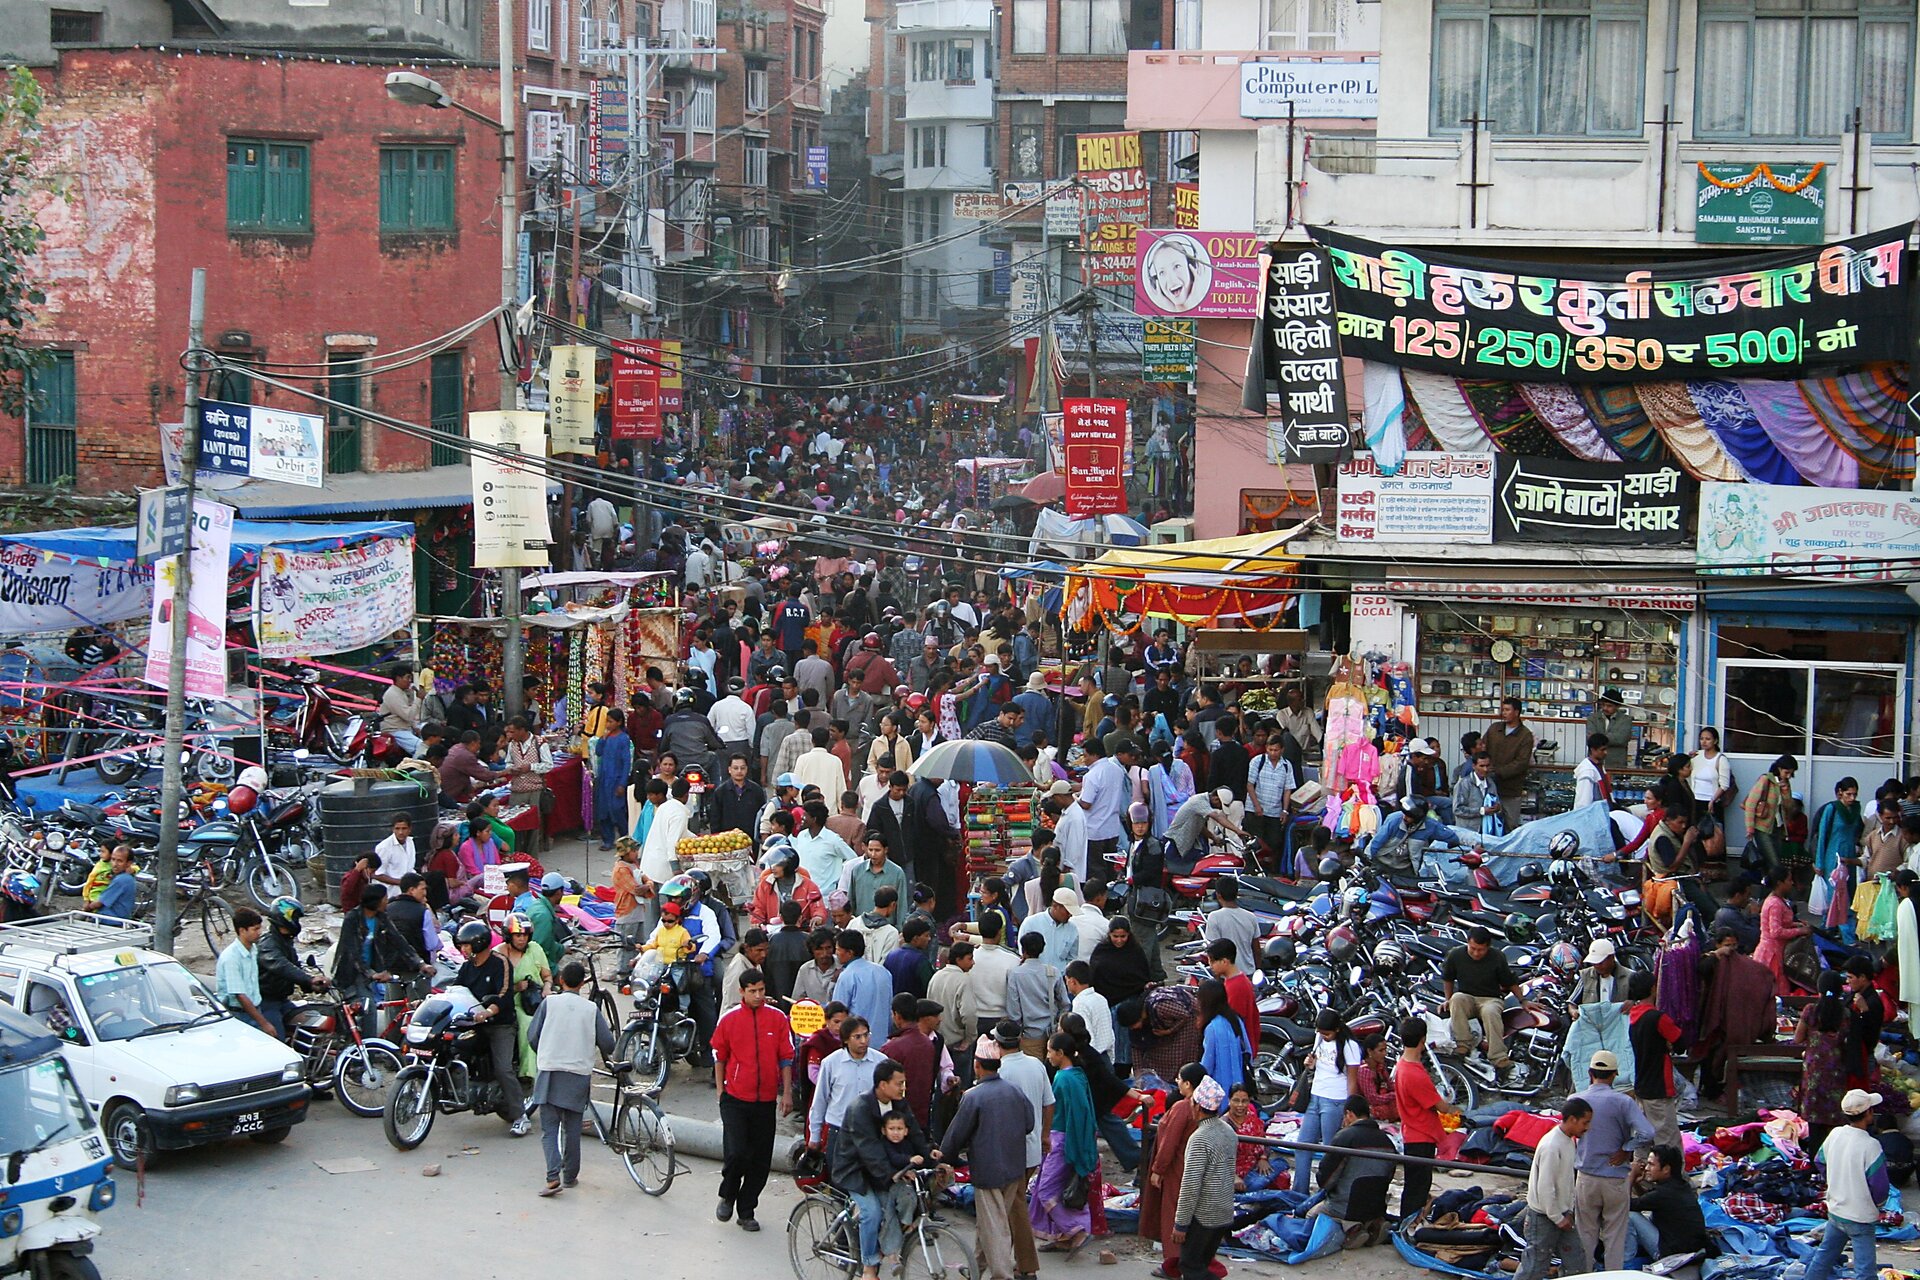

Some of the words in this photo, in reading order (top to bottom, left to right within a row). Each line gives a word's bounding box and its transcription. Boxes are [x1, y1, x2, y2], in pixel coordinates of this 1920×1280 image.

[1258, 66, 1295, 82] Plus
[1245, 78, 1338, 98] Computer
[1108, 169, 1145, 193] SLC
[1698, 215, 1736, 223] SAMJHANA
[1738, 215, 1779, 224] BAHUMUKHI
[1782, 216, 1819, 225] SAHAKARI
[1735, 225, 1771, 235] SANSTHA
[1207, 236, 1258, 259] OSIZ
[1270, 251, 1322, 291] साड़ी
[1330, 246, 1427, 308] साड़ी
[1653, 261, 1816, 318] सलवार
[1817, 239, 1905, 297] पीस
[1268, 286, 1332, 320] संसार
[1145, 322, 1191, 335] OSIZ
[1337, 311, 1386, 341] मात्र
[1272, 319, 1332, 356] पहिलो
[1279, 357, 1339, 383] तल्ला
[665, 397, 679, 405] LG
[1288, 382, 1336, 415] माथी
[1298, 426, 1319, 442] जाने
[1319, 425, 1343, 441] बाटो
[203, 439, 225, 455] KANTI
[228, 443, 246, 458] PATH
[276, 458, 305, 473] Orbit
[1071, 466, 1089, 475] San
[1089, 466, 1115, 476] Miguel
[1624, 466, 1681, 498] साड़ी
[1514, 480, 1565, 515] जाने
[1563, 484, 1617, 517] बाटो
[1620, 501, 1681, 532] संसार
[1354, 597, 1387, 605] ISD
[1608, 598, 1695, 610] RIPARING
[1353, 607, 1393, 616] LOCAL
